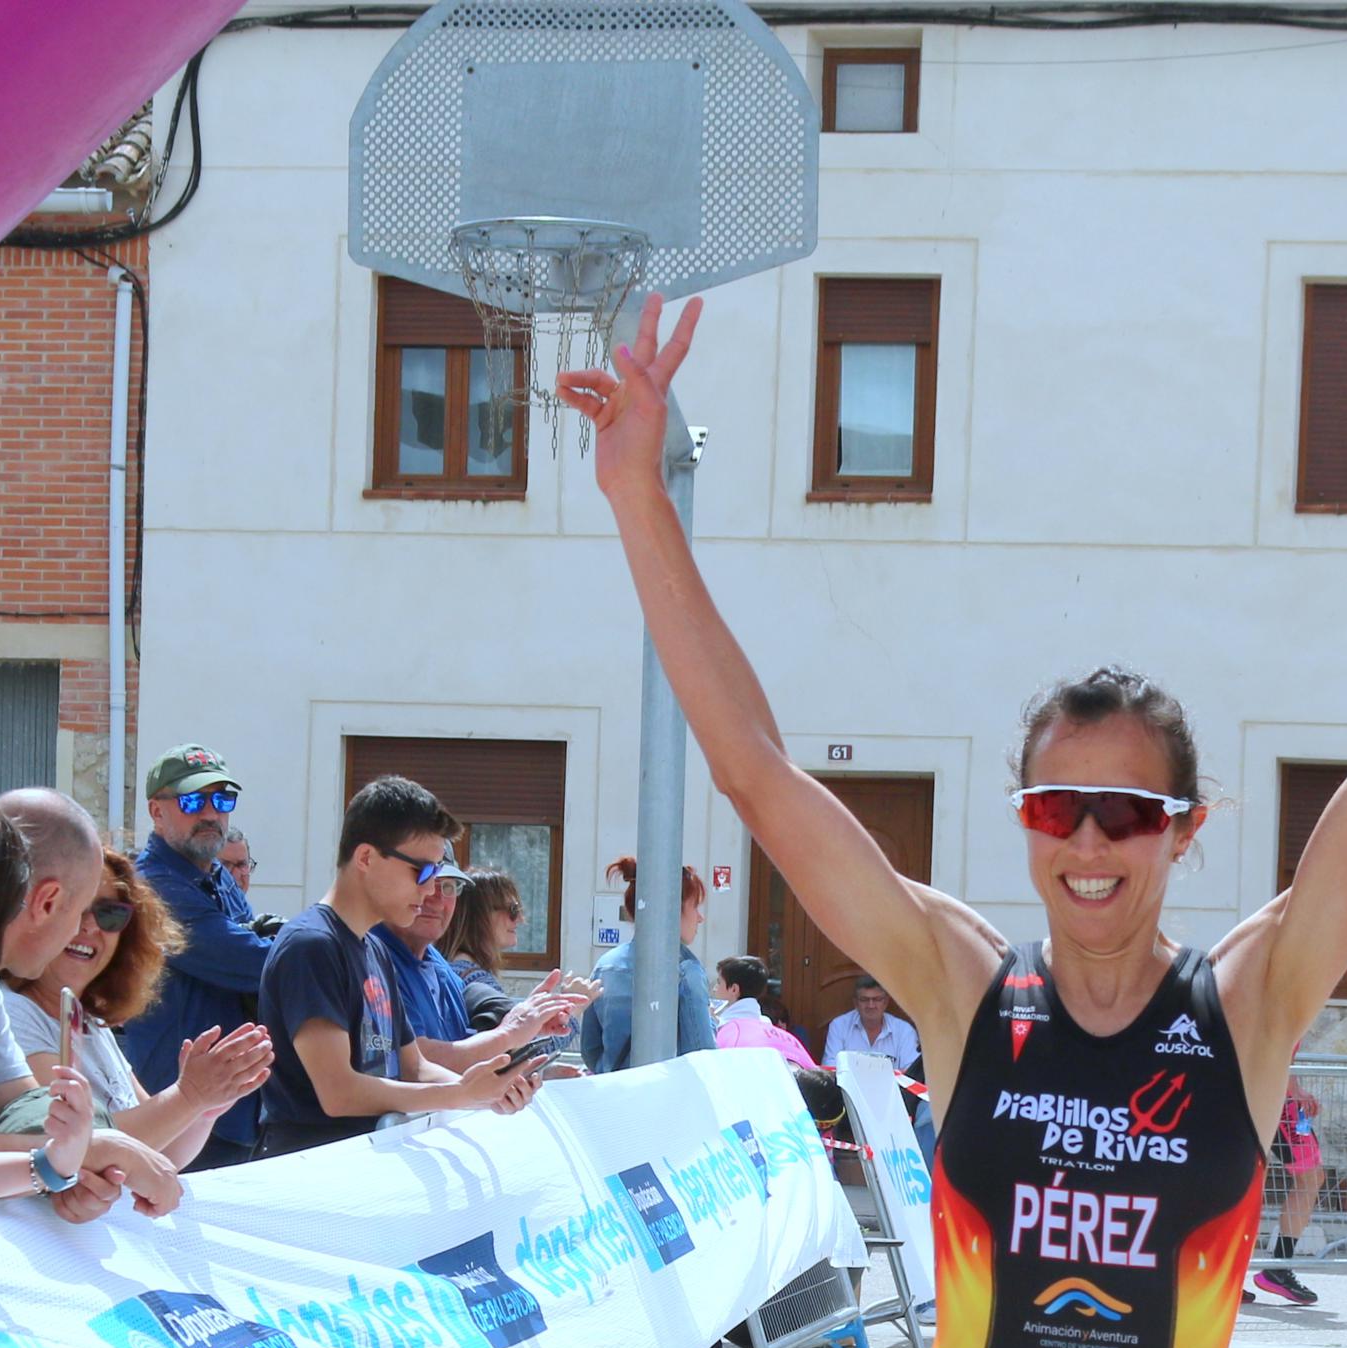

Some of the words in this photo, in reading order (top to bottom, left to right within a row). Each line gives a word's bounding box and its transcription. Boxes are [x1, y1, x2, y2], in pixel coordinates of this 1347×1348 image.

[832, 746, 848, 759] 61
[1039, 1155, 1115, 1172] TRIATLON
[1010, 1171, 1158, 1268] PÉREZ
[471, 1303, 494, 1332] DE
